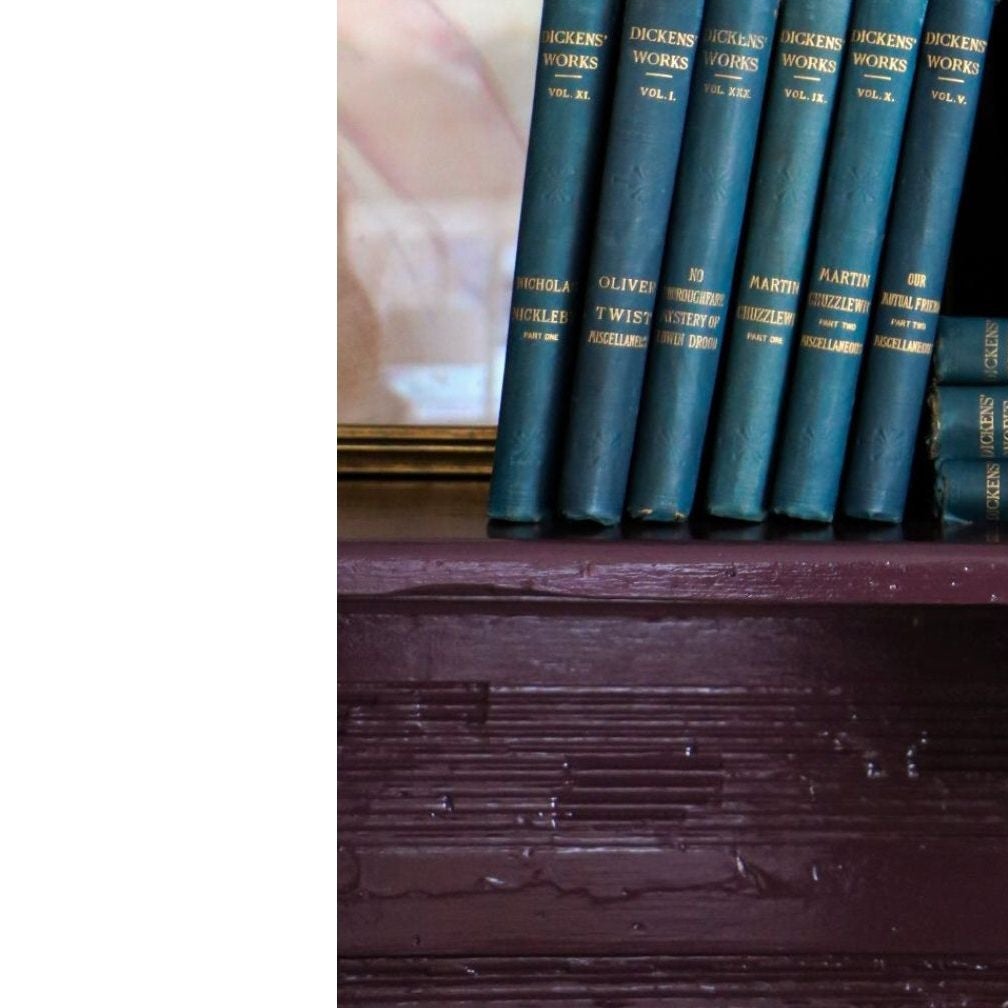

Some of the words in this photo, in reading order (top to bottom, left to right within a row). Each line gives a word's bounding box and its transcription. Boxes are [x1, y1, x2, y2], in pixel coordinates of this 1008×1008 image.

[630, 26, 698, 48] DICKENS'
[852, 29, 917, 51] DICKENS'
[543, 52, 599, 70] WORKS
[633, 50, 689, 70] WORKS
[704, 50, 759, 72] WORKS
[783, 53, 837, 73] WORKS
[853, 52, 908, 73] WORKS
[928, 54, 980, 76] WORKS
[688, 267, 704, 283] NO
[750, 275, 799, 295] MARTIN
[819, 267, 870, 288] MARTIN
[907, 272, 927, 288] OUR
[596, 306, 651, 326] TWIST
